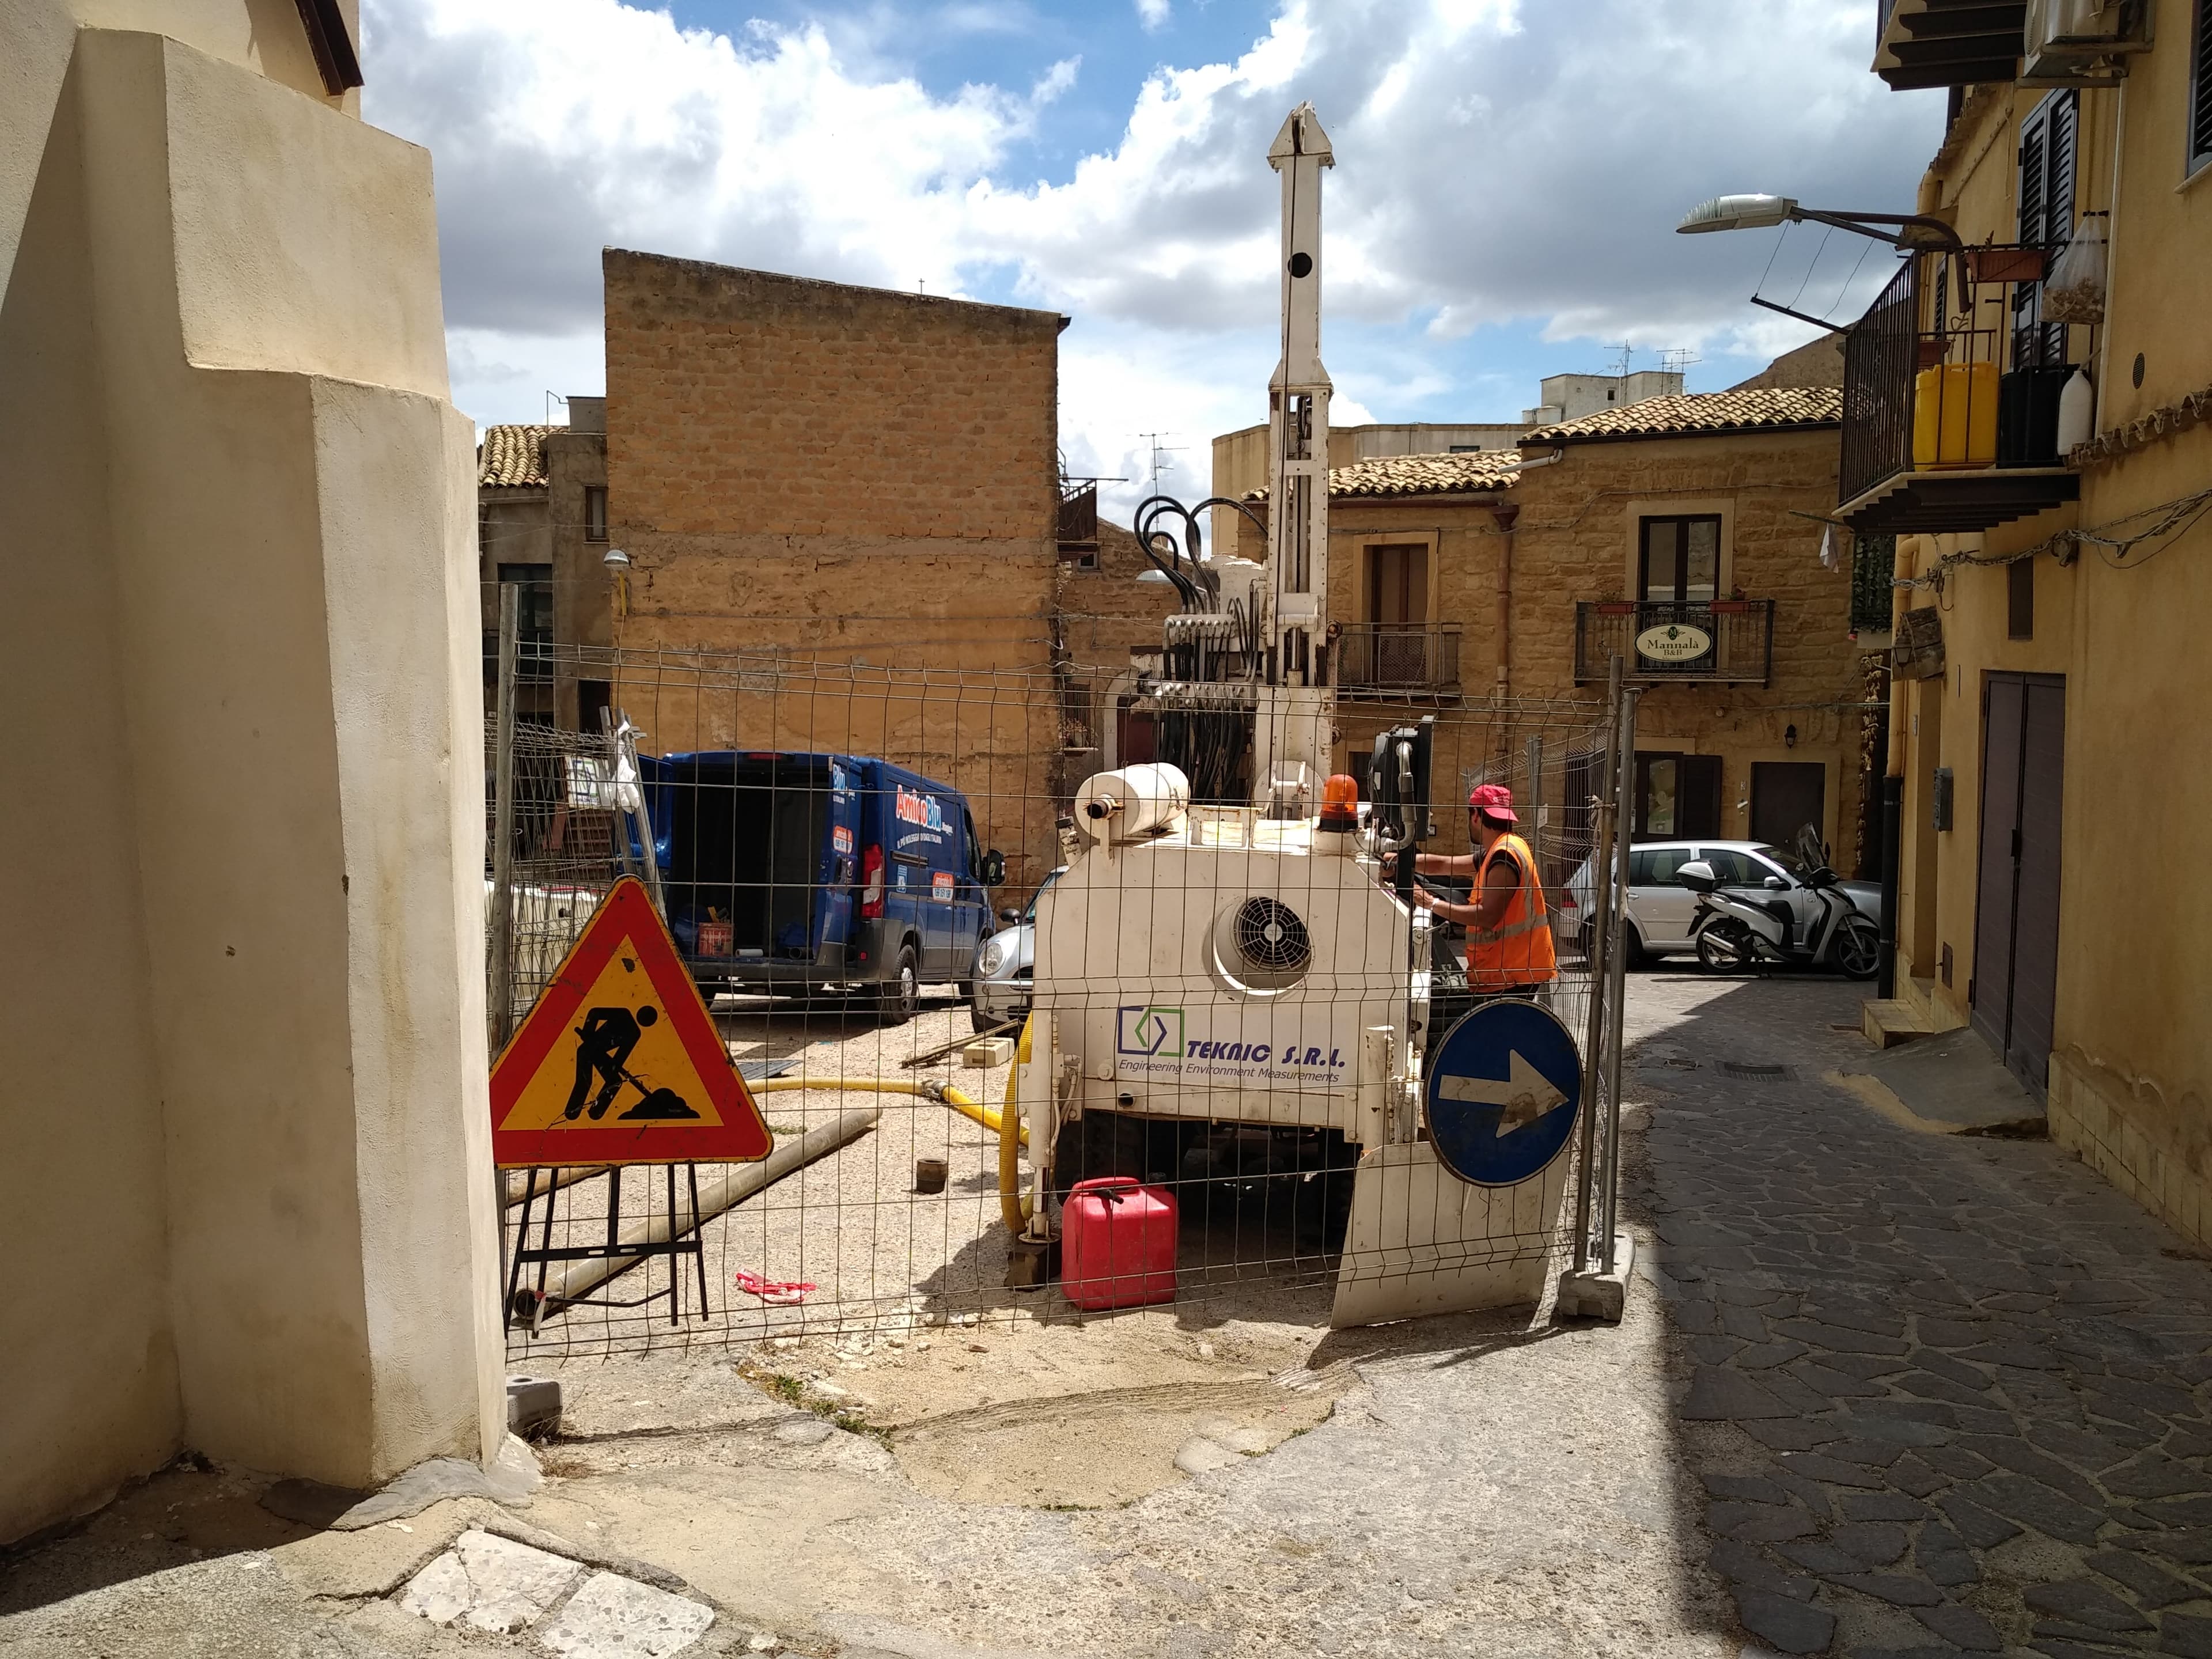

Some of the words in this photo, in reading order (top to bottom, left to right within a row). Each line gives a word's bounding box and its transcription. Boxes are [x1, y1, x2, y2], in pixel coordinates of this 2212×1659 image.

[1647, 637, 1699, 649] Mannalà
[896, 784, 942, 832] AmicoBlu
[1187, 1040, 1271, 1062] TEKNIC
[1281, 1046, 1346, 1068] S.R.L.
[1119, 1059, 1183, 1075] Engineering
[1185, 1063, 1255, 1078] Environment
[1257, 1067, 1340, 1082] Measurements
